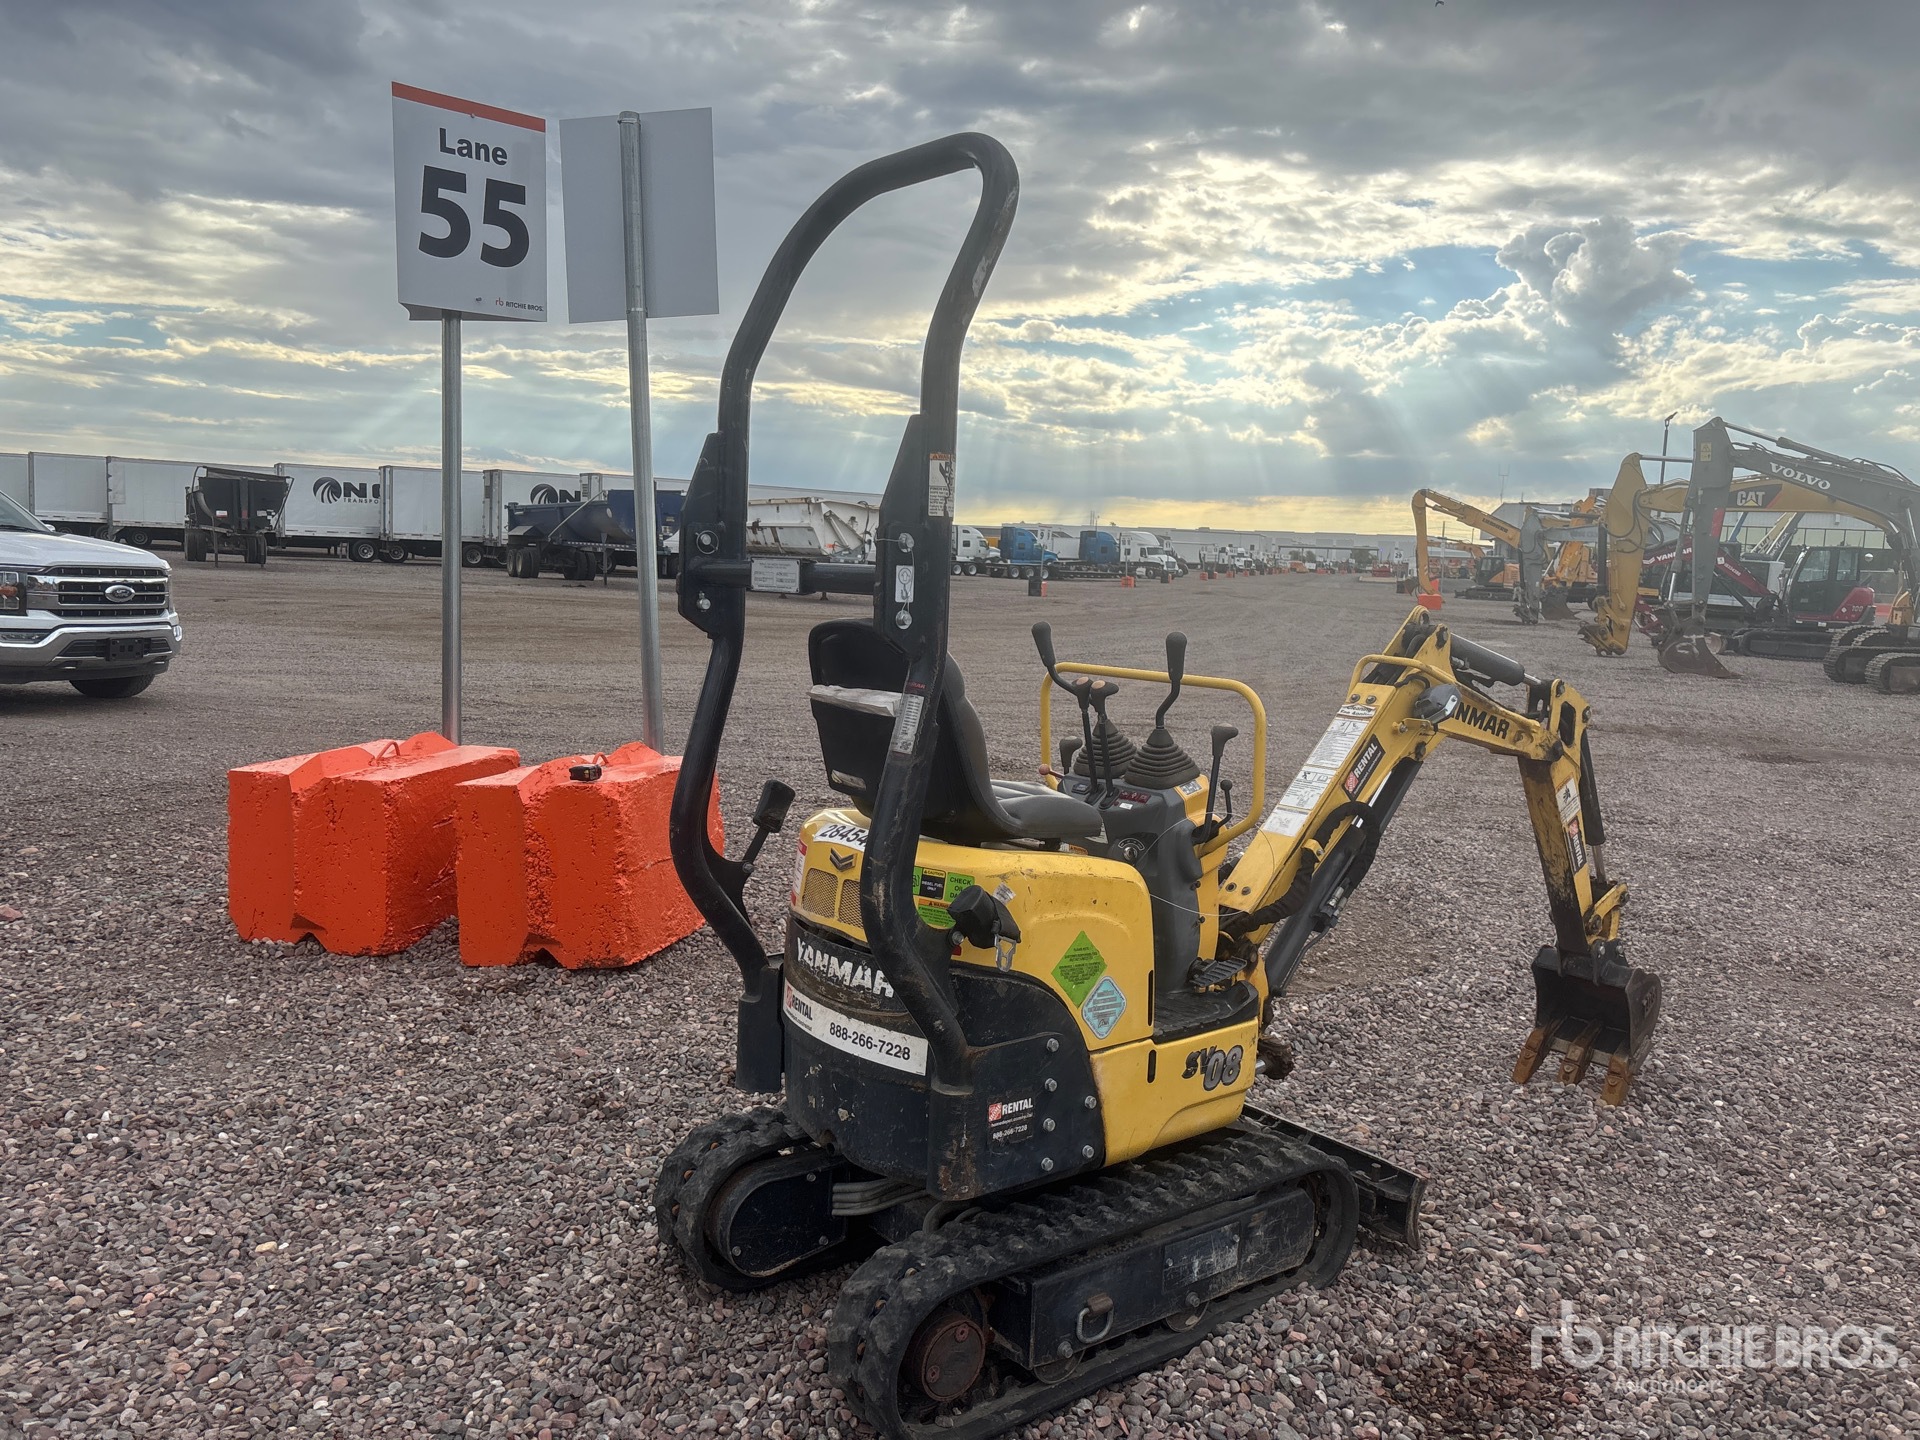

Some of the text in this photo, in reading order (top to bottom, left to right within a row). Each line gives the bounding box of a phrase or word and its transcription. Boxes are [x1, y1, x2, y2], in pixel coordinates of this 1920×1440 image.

[439, 127, 508, 166] Lane
[418, 165, 530, 268] 55
[505, 301, 527, 310] RITCHIE
[1770, 462, 1831, 490] VOLVO
[1736, 491, 1766, 507] CAT
[1454, 701, 1511, 740] NMAR
[1353, 743, 1378, 778] RENTAL
[1572, 836, 1584, 868] RENTAL
[949, 876, 972, 886] CHECK
[797, 937, 894, 998] YANMAR
[792, 994, 813, 1021] RENTAL
[829, 1022, 911, 1061] 888-266-7228
[1002, 1098, 1033, 1116] RENTAL
